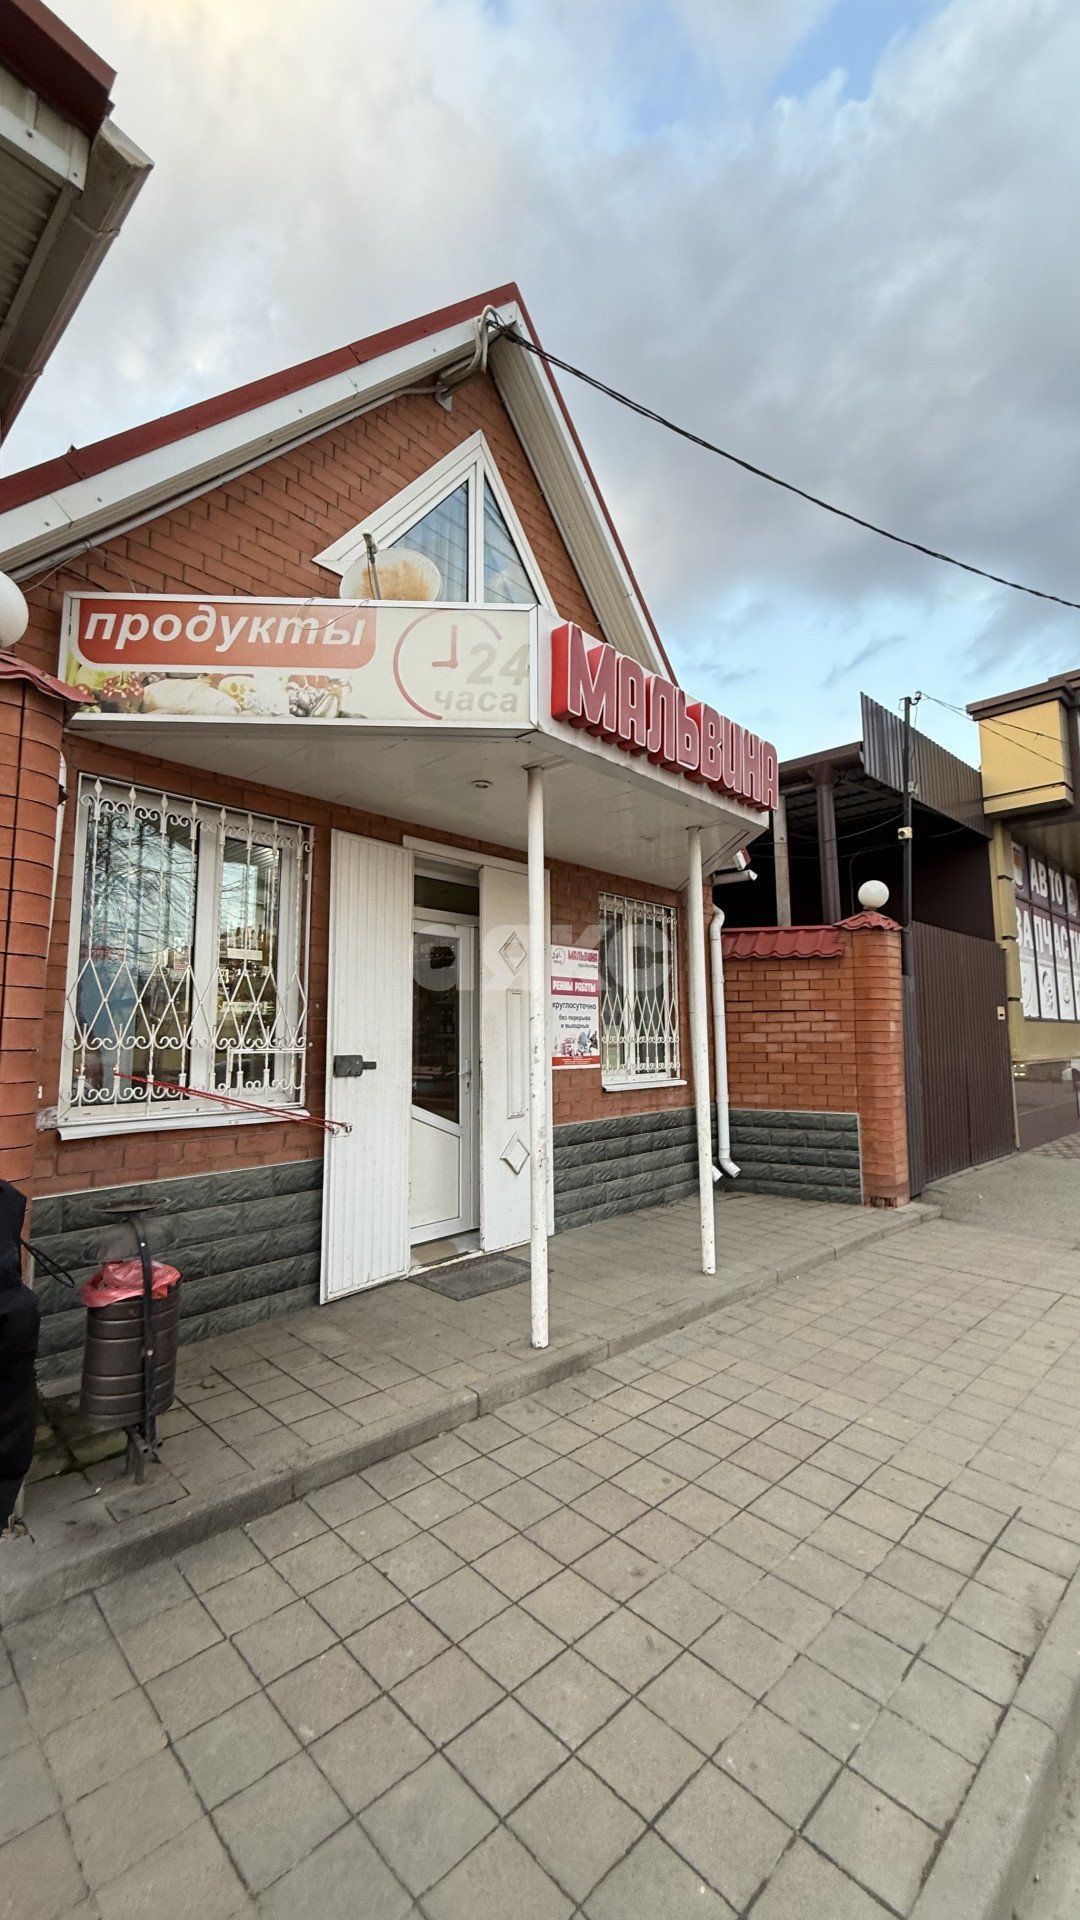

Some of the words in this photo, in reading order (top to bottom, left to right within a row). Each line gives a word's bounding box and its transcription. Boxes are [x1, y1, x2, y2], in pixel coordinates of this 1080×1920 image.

[84, 604, 366, 652] продукты
[466, 642, 530, 686] 24
[434, 689, 519, 713] часа
[553, 621, 779, 811] МАЛЬВИНА
[1030, 858, 1064, 906] АВТО
[574, 981, 596, 993] РАБОТЫ
[552, 1001, 597, 1010] круглосуточно
[558, 1013, 567, 1021] без
